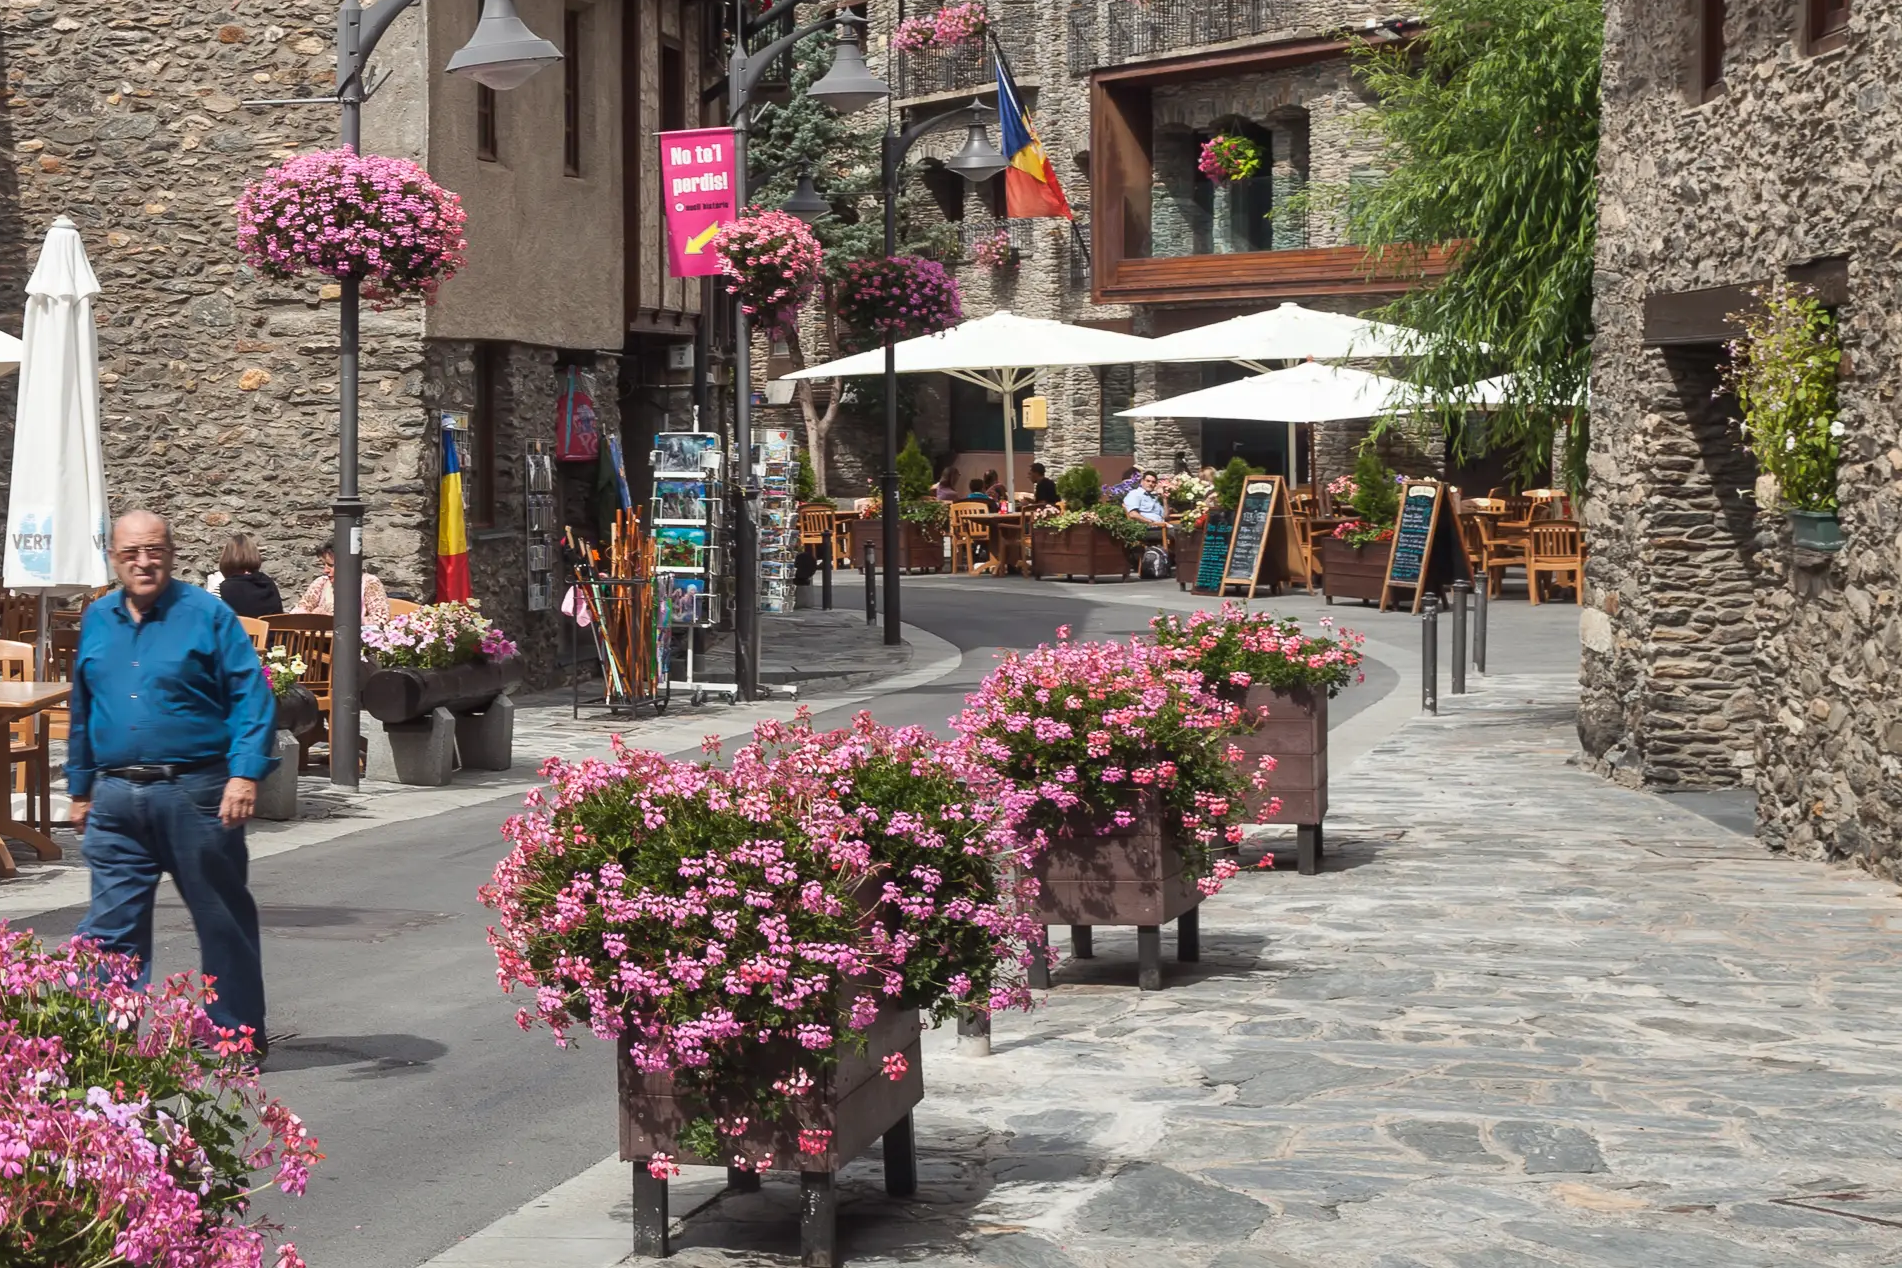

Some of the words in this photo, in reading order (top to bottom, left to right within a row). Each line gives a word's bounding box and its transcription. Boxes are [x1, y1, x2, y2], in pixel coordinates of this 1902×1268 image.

[670, 147, 691, 165] No
[694, 143, 723, 164] te'l
[672, 171, 729, 197] perdis!
